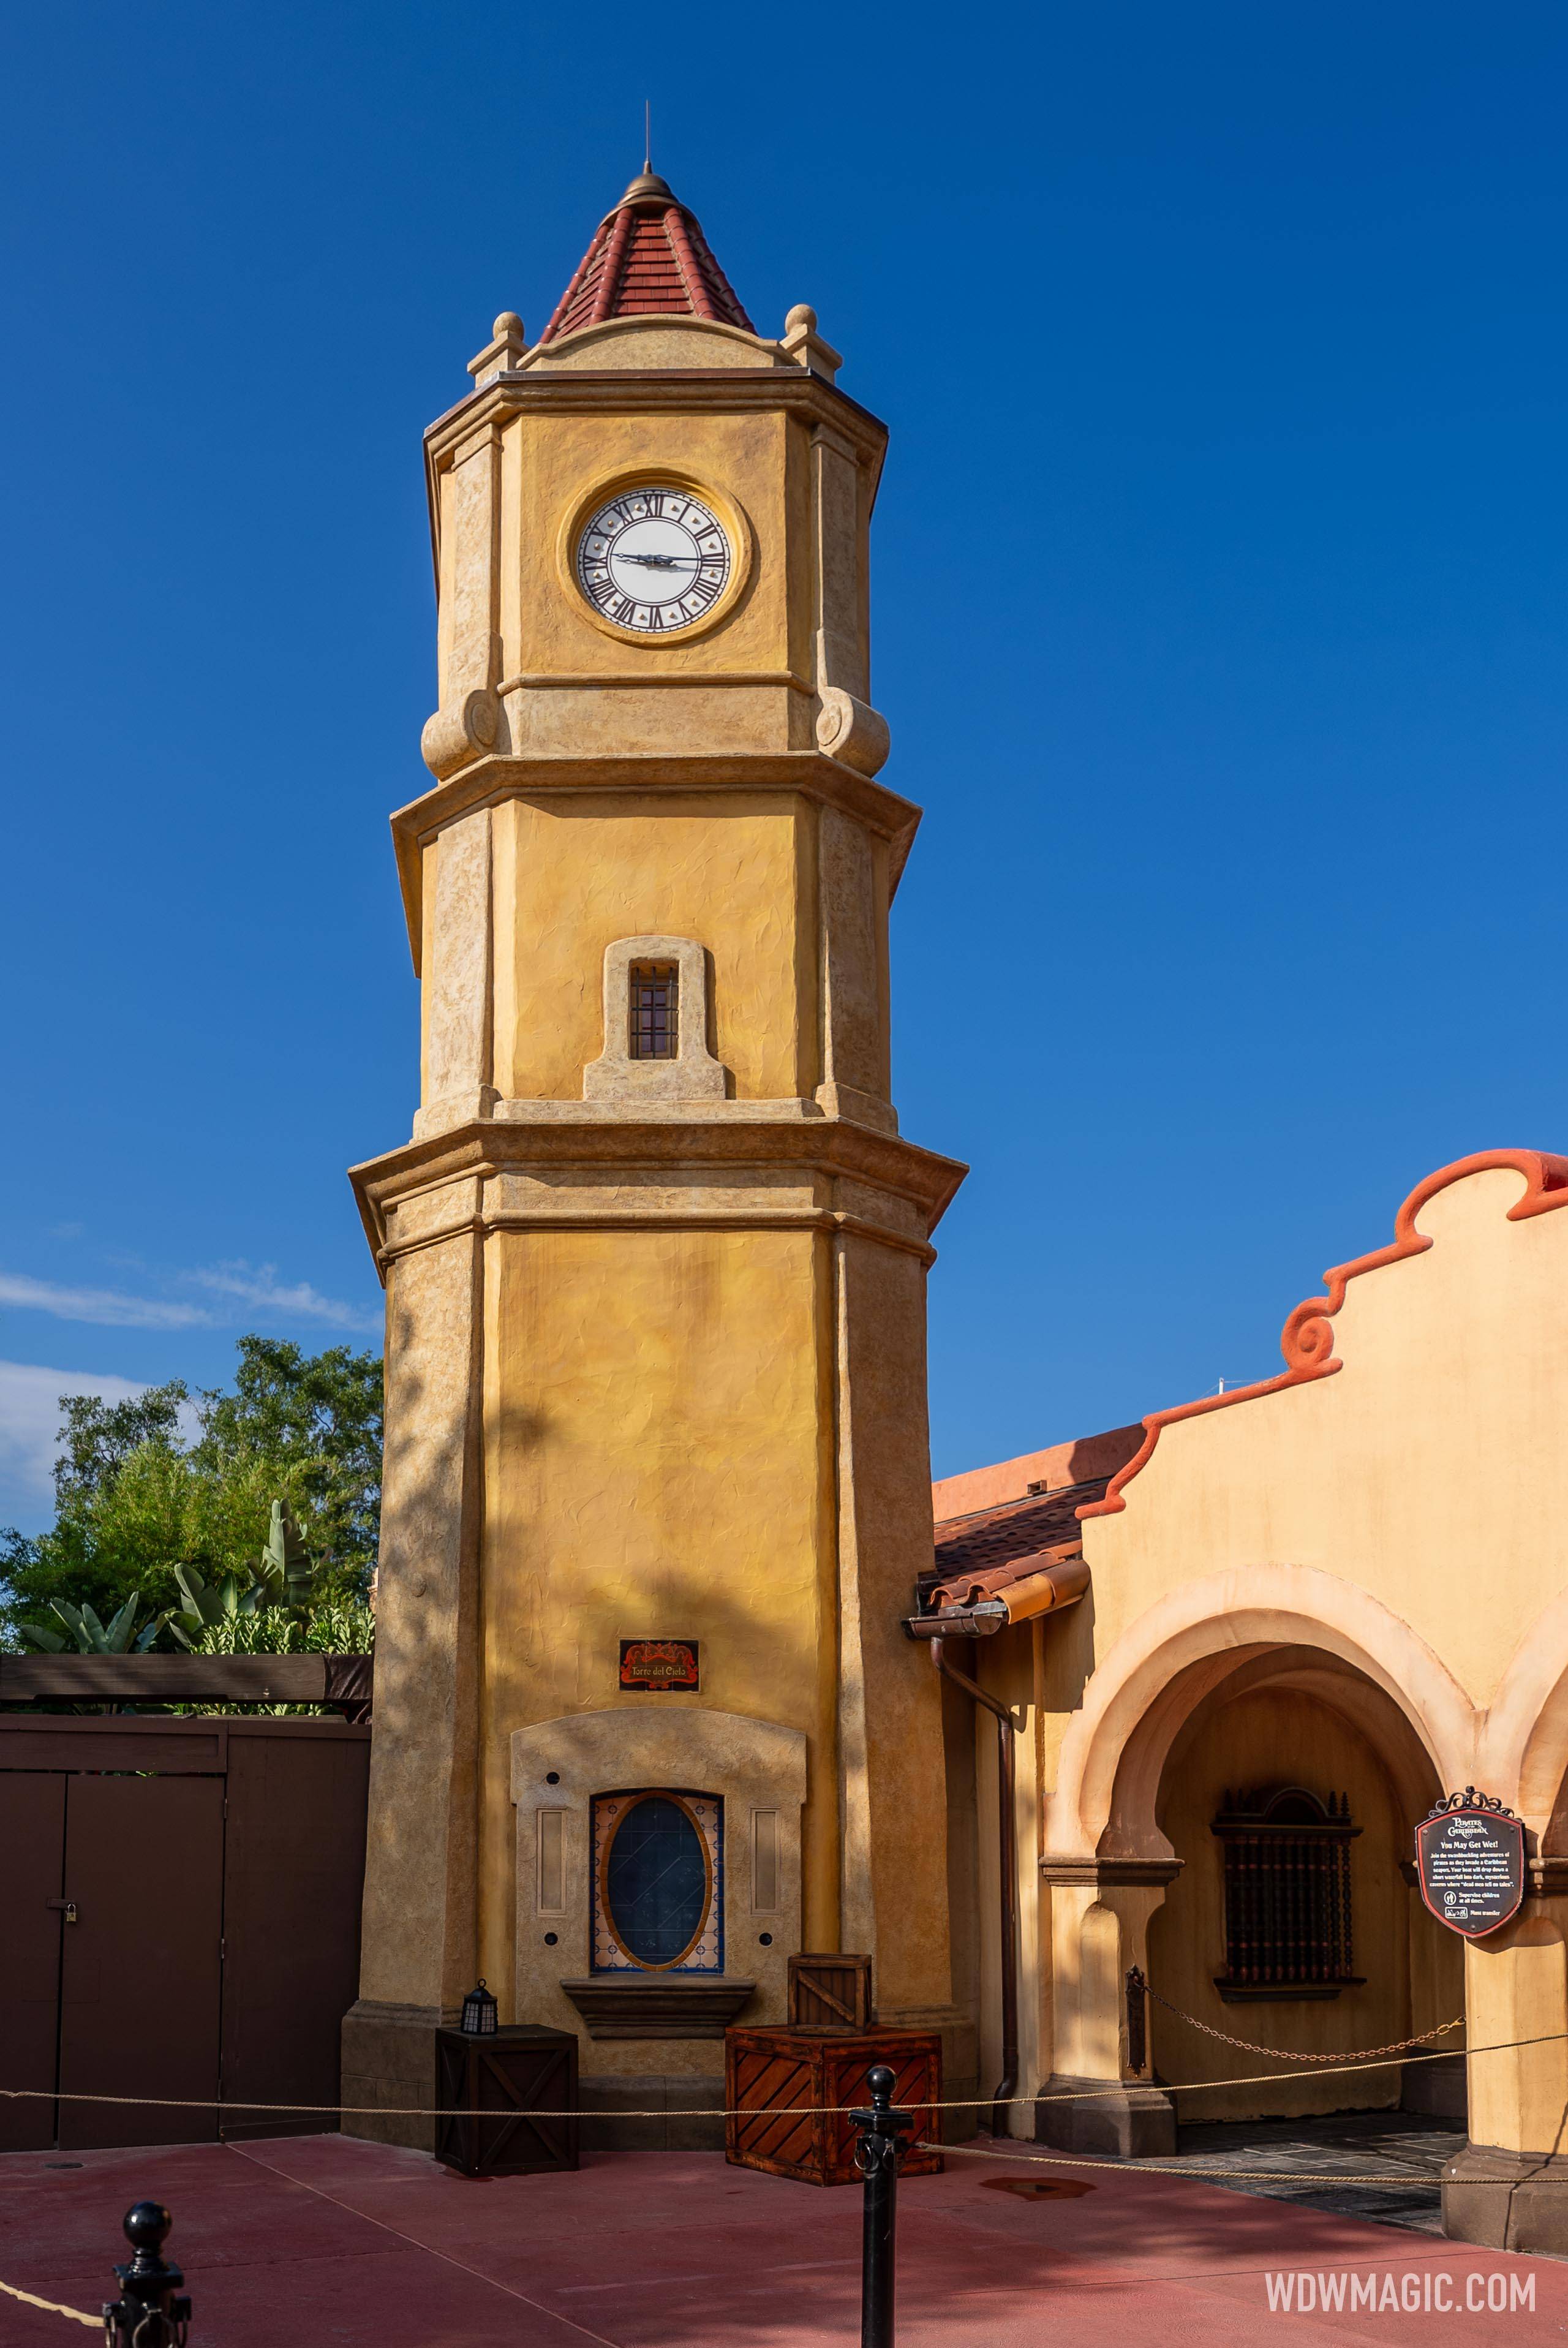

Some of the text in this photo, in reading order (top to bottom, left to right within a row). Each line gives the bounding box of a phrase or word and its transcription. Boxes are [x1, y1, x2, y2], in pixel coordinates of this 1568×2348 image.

[632, 1666, 686, 1676] Torre del Cielo
[1452, 1818, 1482, 1828] PIRATES
[1447, 1827, 1488, 1839] CARIBBEAN
